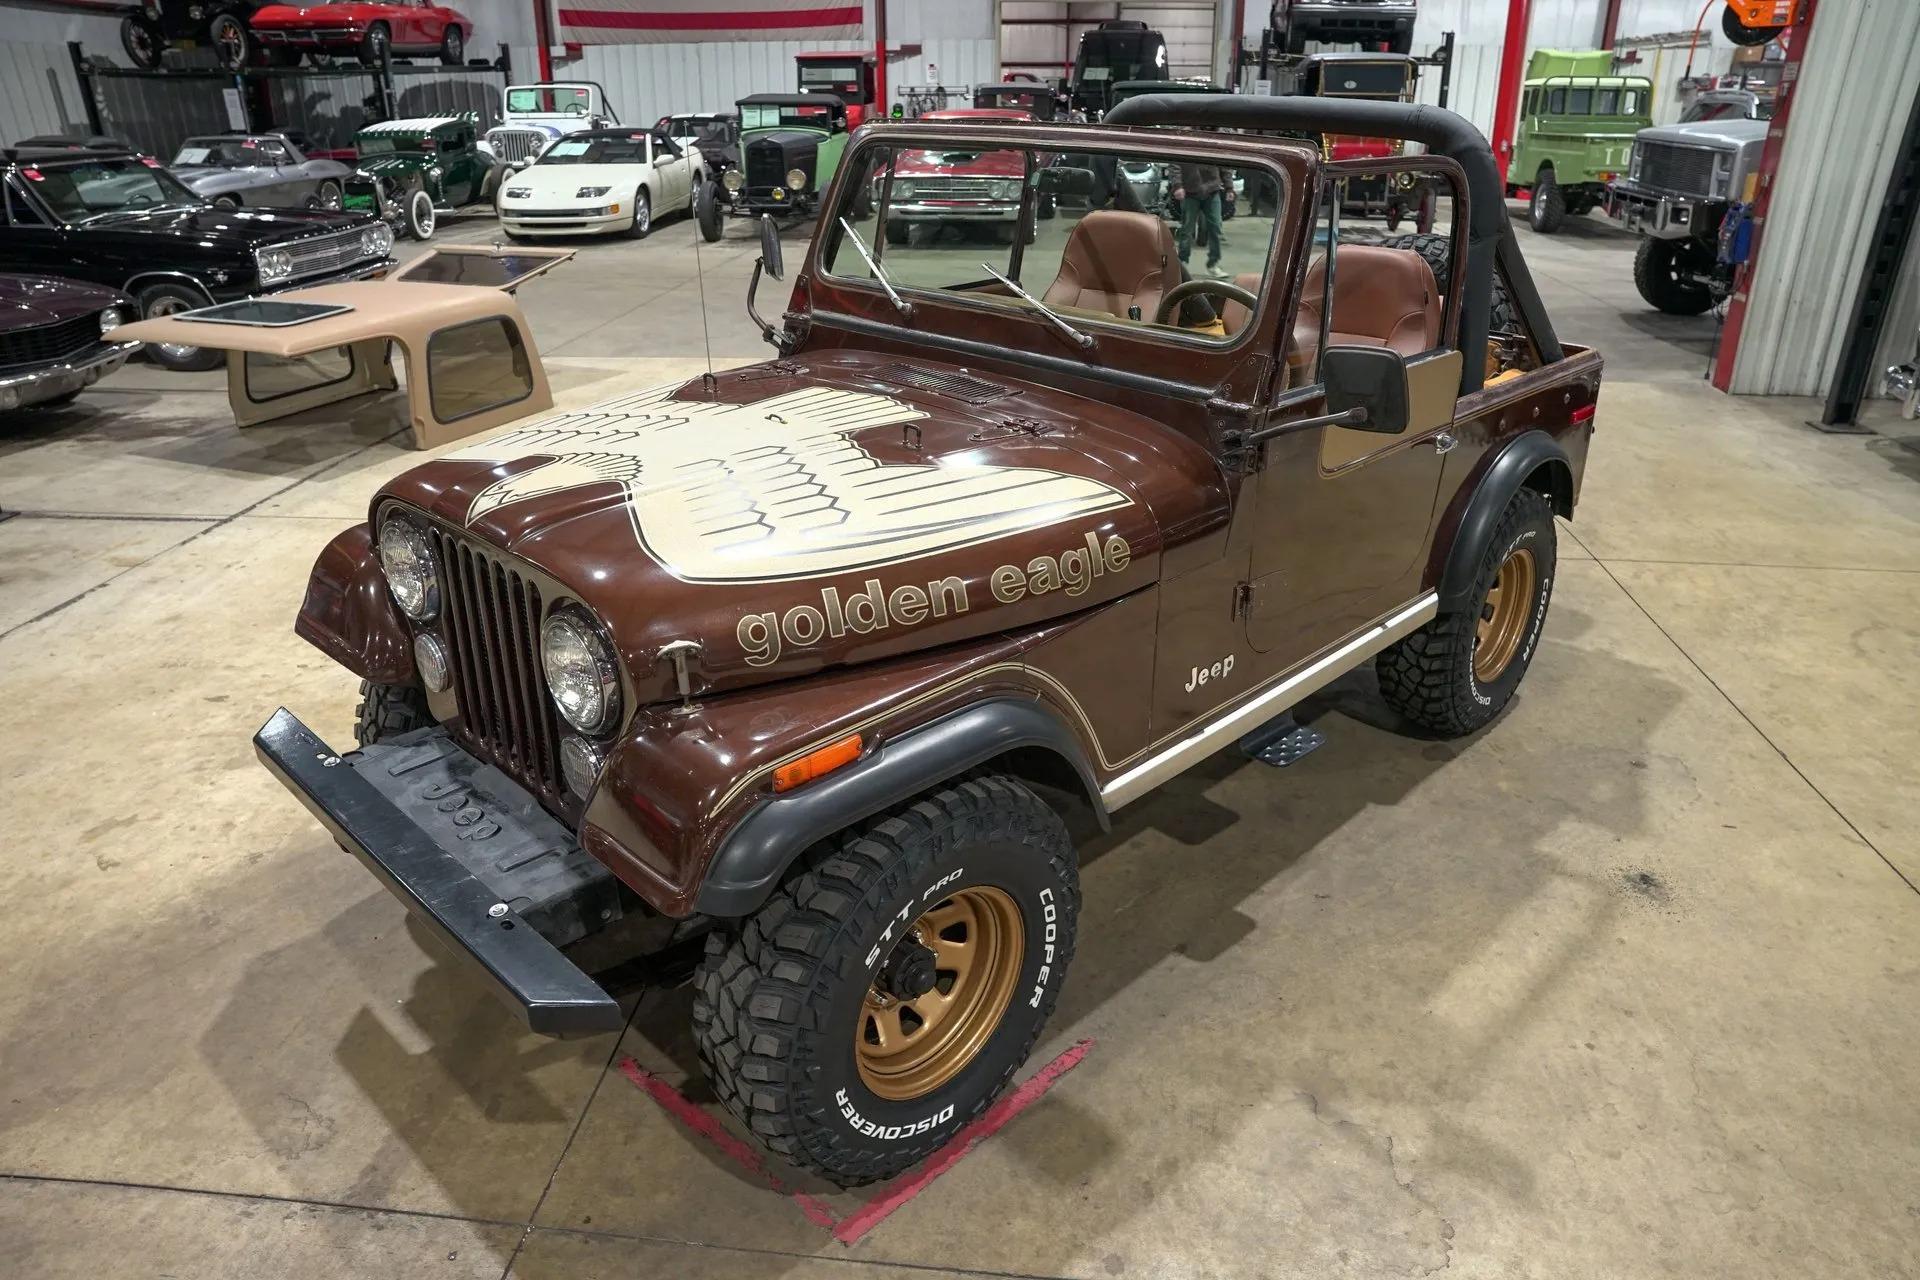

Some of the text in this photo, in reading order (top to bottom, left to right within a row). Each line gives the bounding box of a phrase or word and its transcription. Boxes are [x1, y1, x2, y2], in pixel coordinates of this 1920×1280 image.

[736, 531, 1132, 668] golden eagle
[1522, 577, 1549, 661] COOPER
[1184, 654, 1235, 693] Jeep
[422, 783, 502, 841] Jeep
[865, 867, 964, 970] STT PRO
[1028, 887, 1057, 1009] COOPER
[834, 1087, 955, 1140] DISCOVERER
